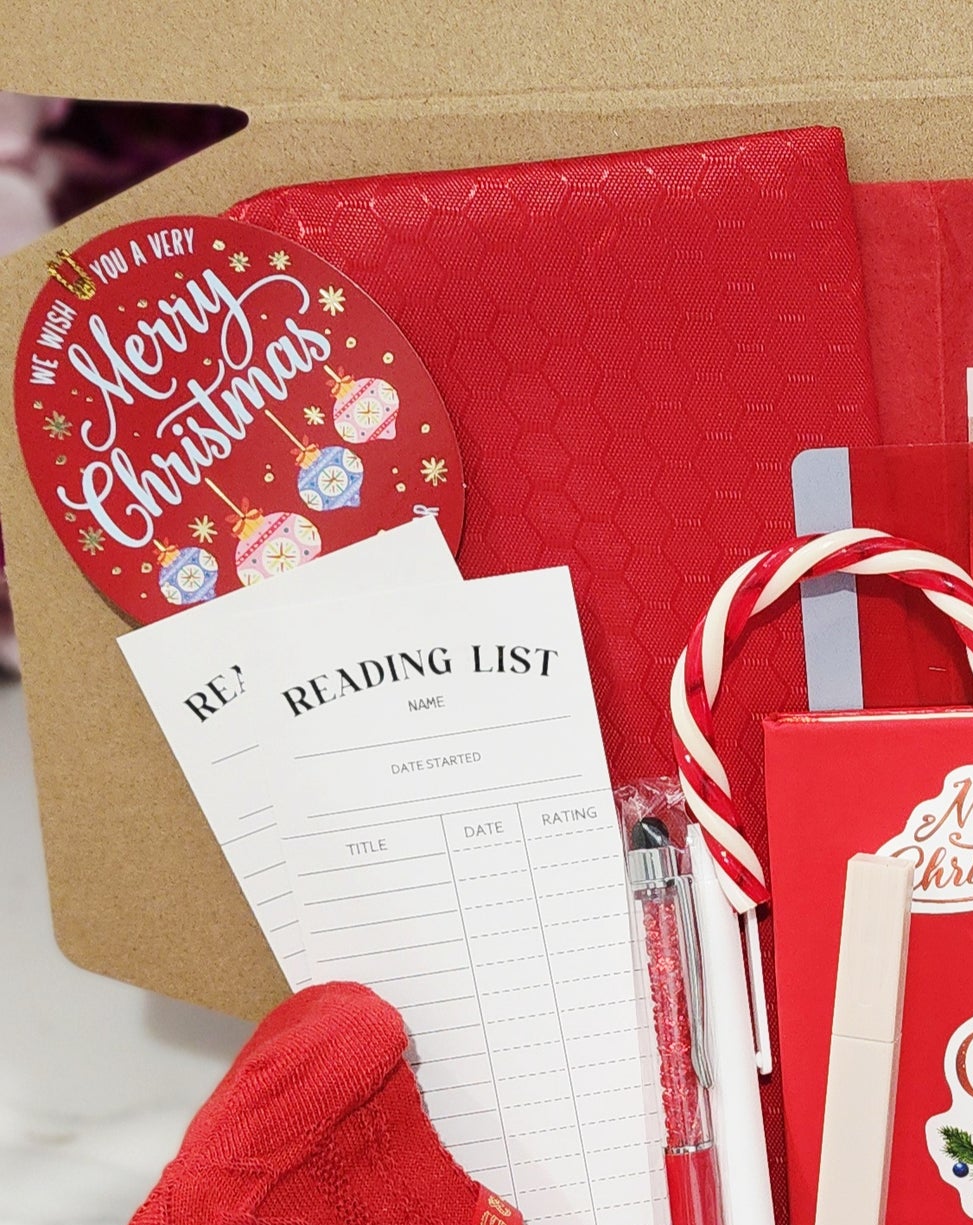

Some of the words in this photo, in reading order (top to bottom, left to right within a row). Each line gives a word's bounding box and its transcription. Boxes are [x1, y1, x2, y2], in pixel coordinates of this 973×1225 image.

[130, 240, 147, 267] A
[148, 227, 194, 258] VERY
[89, 248, 128, 284] YOU
[37, 299, 77, 352] WISH
[30, 353, 58, 385] WE
[67, 269, 311, 451] Merry
[57, 319, 331, 548] Christmas
[280, 646, 452, 718] READING
[471, 644, 558, 678] LIST
[408, 697, 445, 713] NAME
[391, 759, 424, 774] DATE
[427, 752, 481, 771] STARTED
[464, 821, 503, 839] DATE
[541, 806, 598, 827] RATING
[346, 839, 387, 856] TITLE
